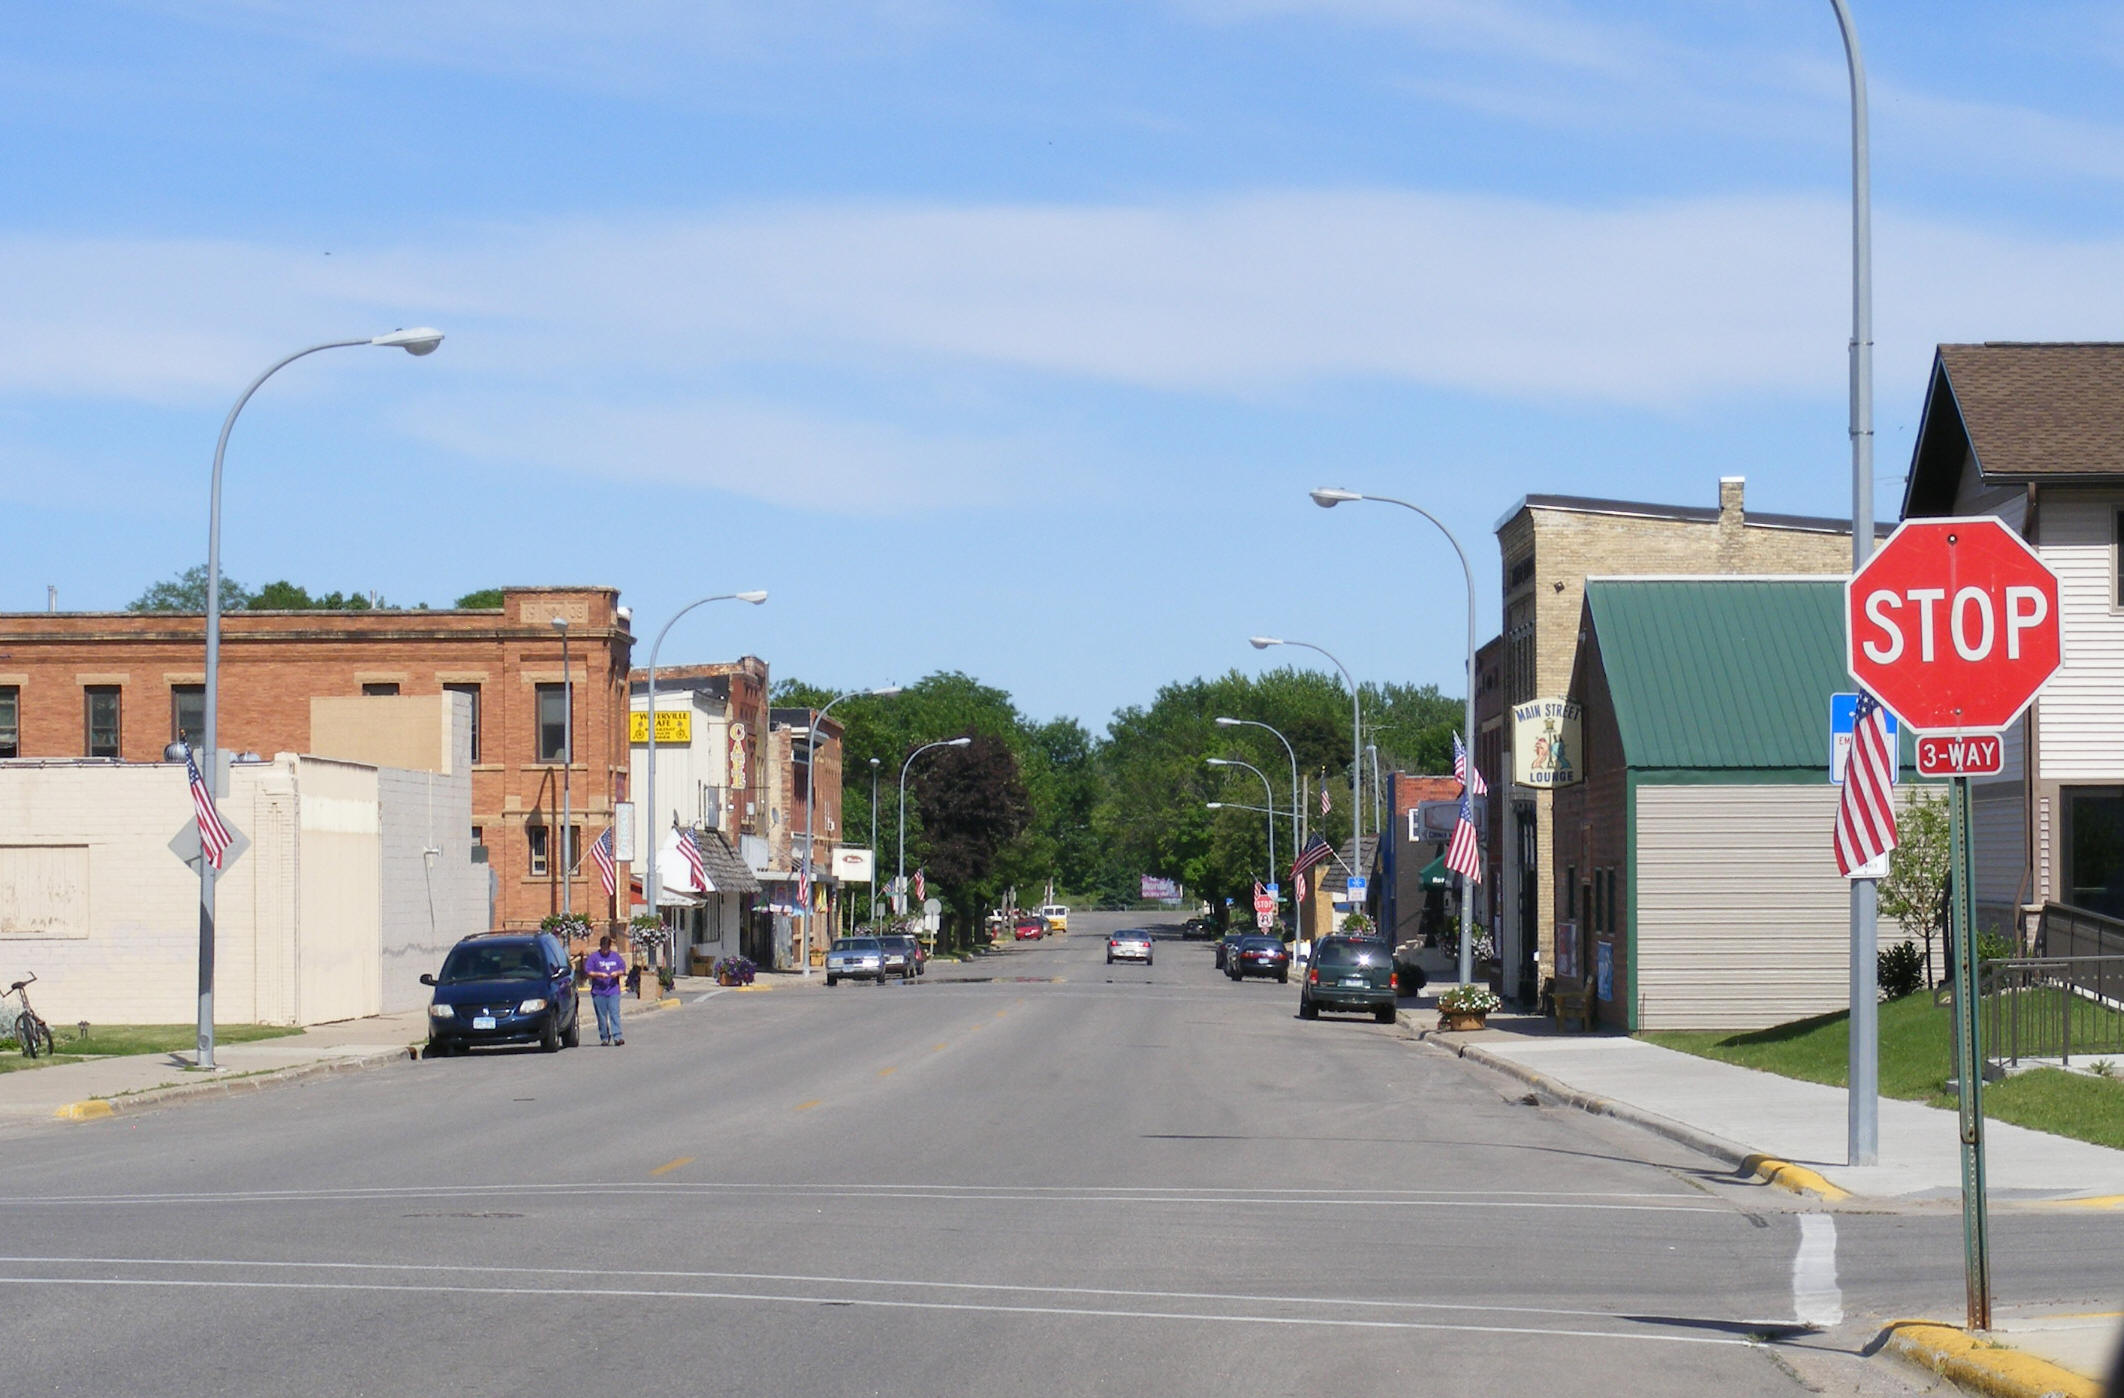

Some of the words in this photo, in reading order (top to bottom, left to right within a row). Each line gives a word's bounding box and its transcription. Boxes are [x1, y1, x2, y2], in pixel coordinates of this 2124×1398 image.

[1861, 585, 2049, 665] STOP
[1515, 704, 1541, 723] MAIN
[1545, 703, 1580, 721] STREET
[1923, 741, 1996, 769] 3-WAY
[1530, 771, 1574, 783] LOUNGE
[1256, 899, 1272, 909] STOP
